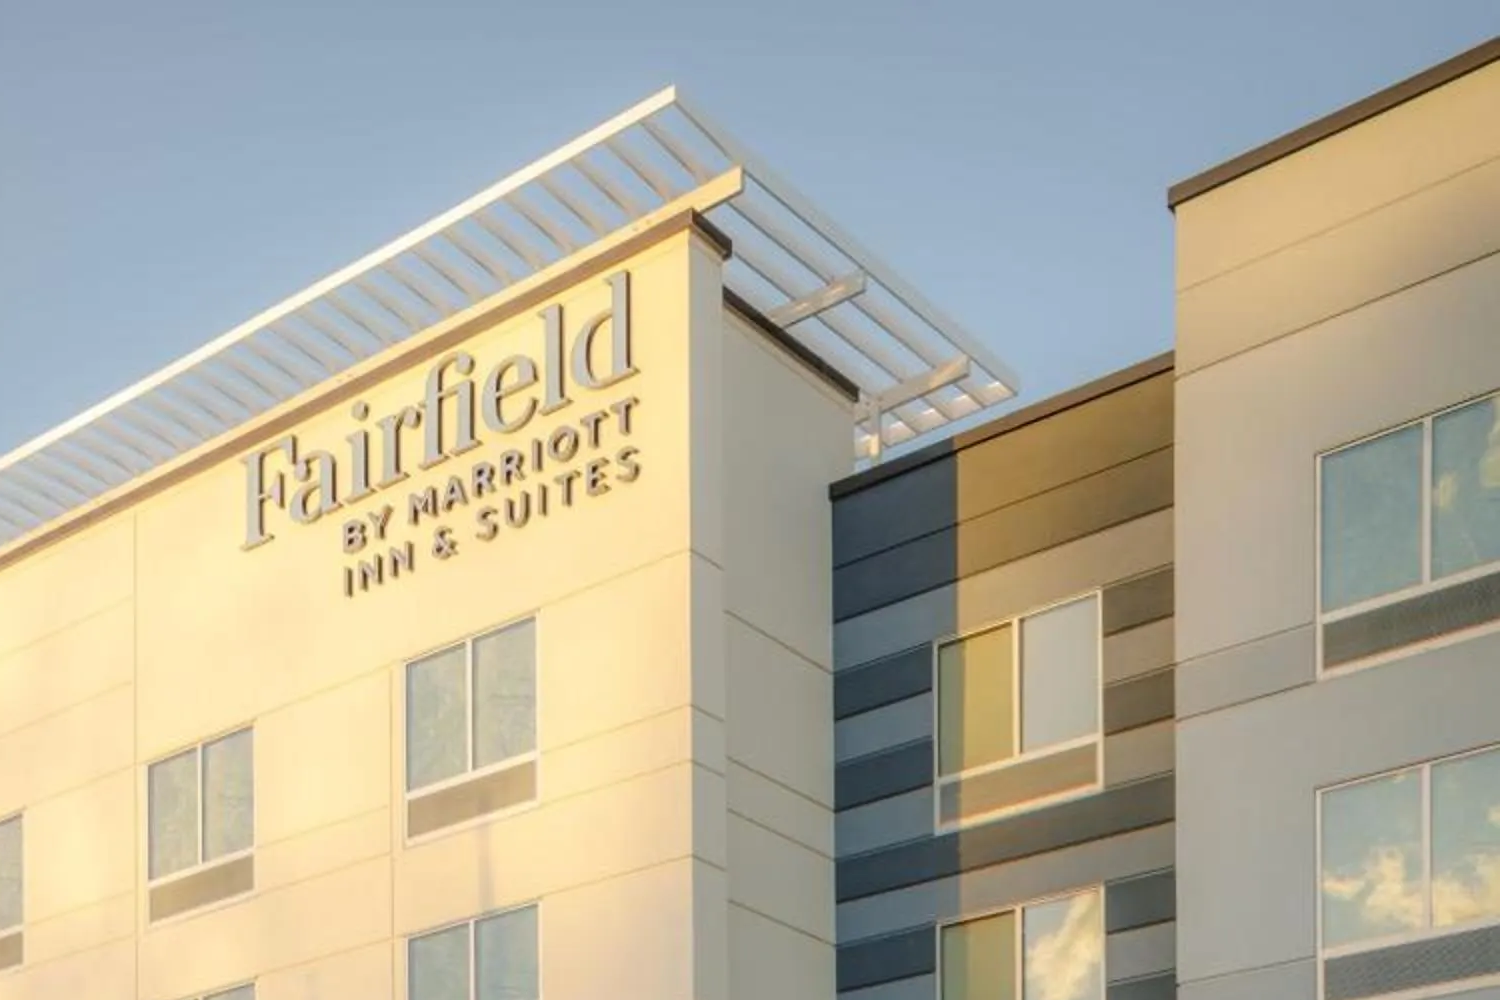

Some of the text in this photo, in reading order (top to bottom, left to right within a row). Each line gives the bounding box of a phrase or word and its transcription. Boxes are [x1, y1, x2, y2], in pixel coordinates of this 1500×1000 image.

[240, 270, 641, 552] Fairfield
[343, 397, 640, 554] BY MARRIOTT
[343, 447, 642, 598] INN & SUITES
